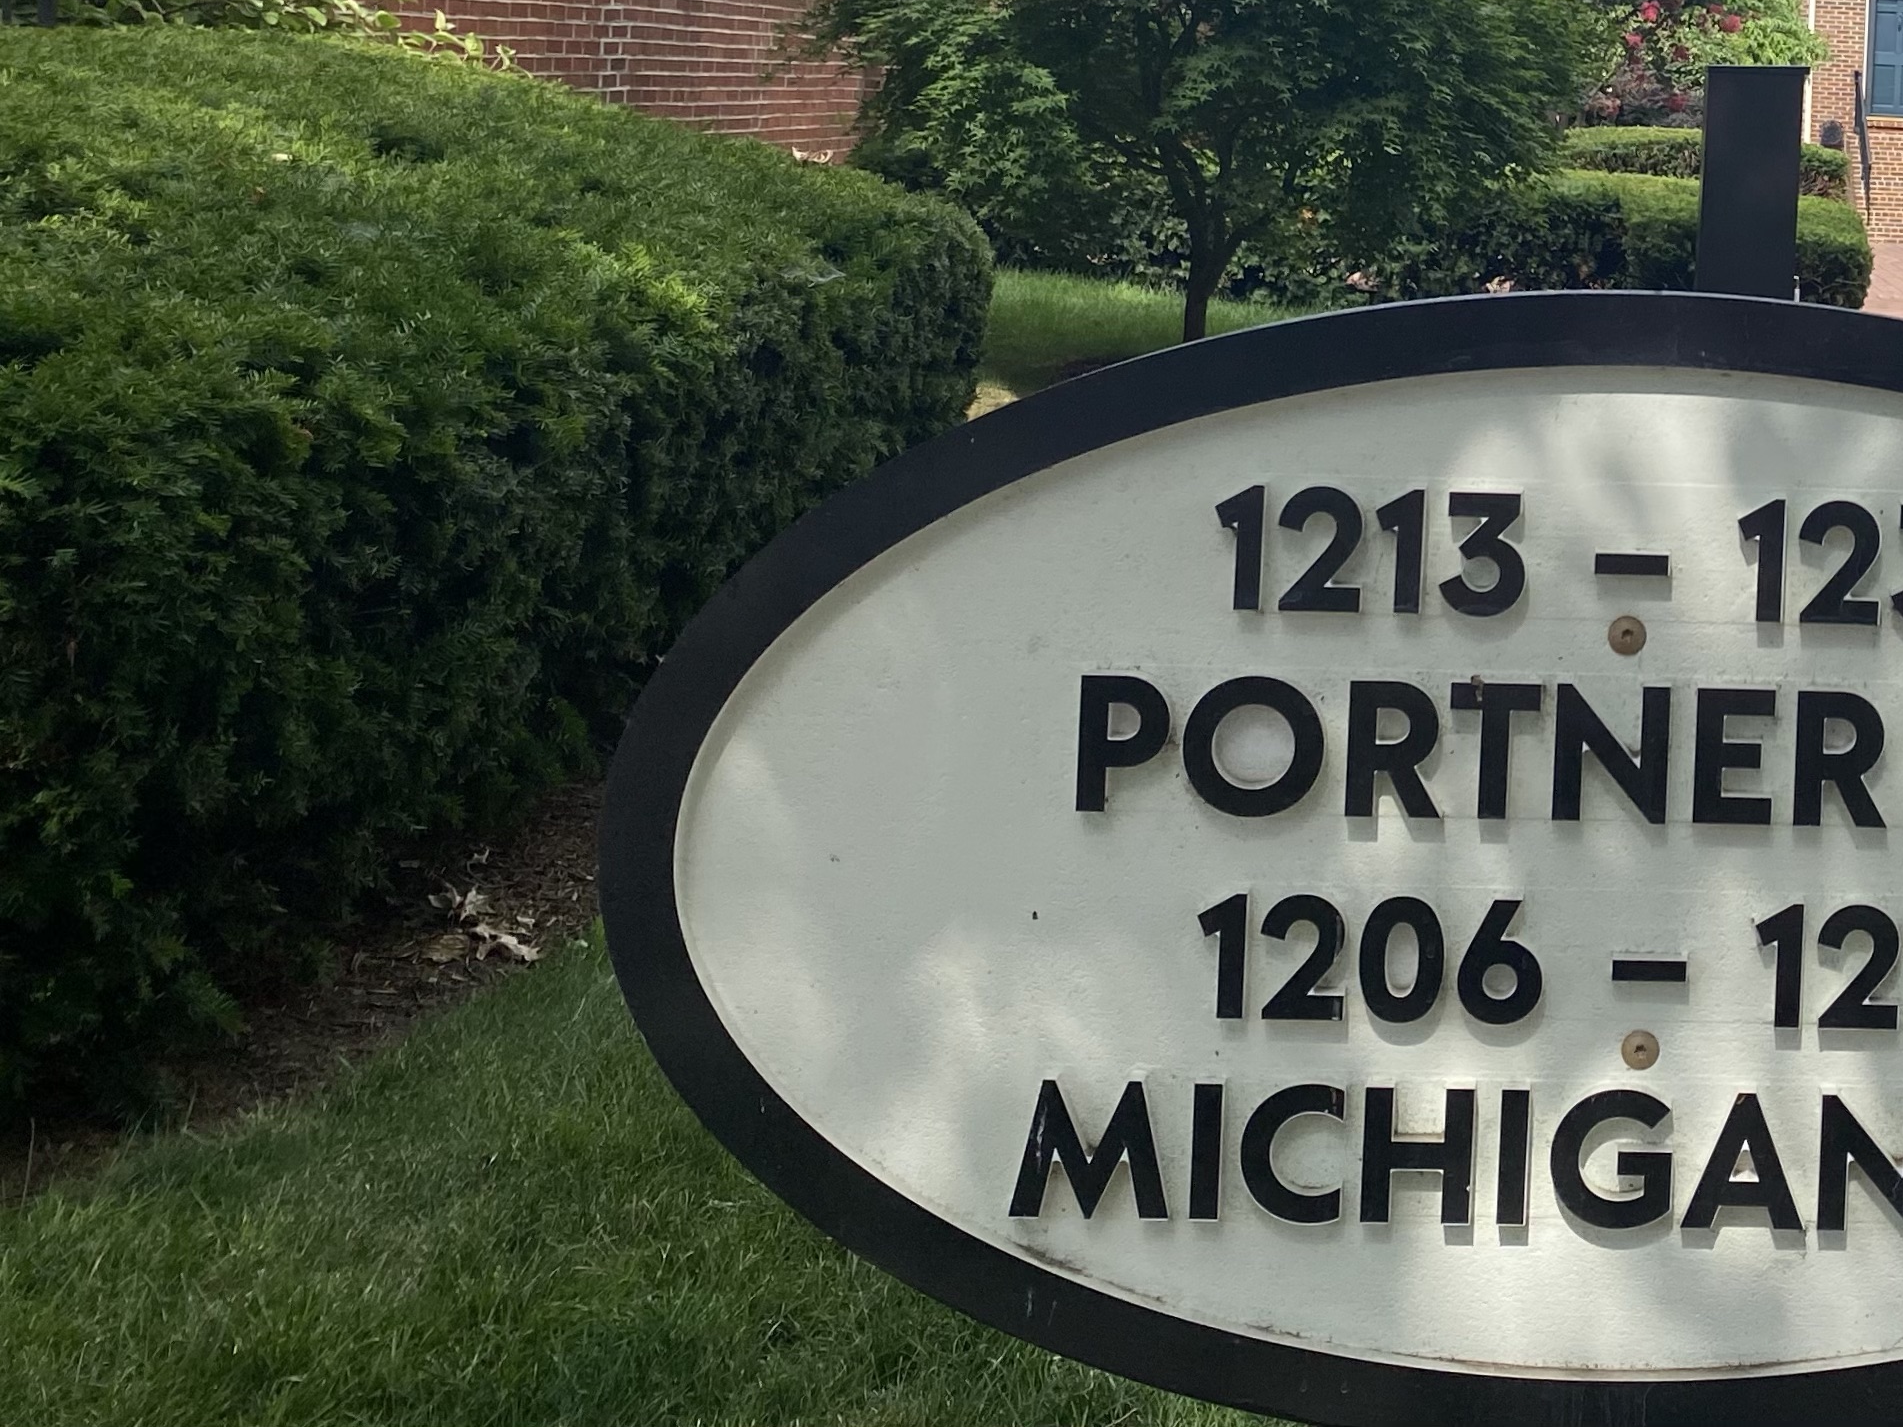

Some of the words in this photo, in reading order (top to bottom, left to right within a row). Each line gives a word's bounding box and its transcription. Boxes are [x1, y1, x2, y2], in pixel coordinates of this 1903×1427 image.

[1215, 485, 1525, 617] 1213
[1595, 554, 1668, 578] -
[1076, 675, 1886, 827] PORTNER
[1198, 894, 1542, 1025] 1206
[1612, 960, 1687, 982] -
